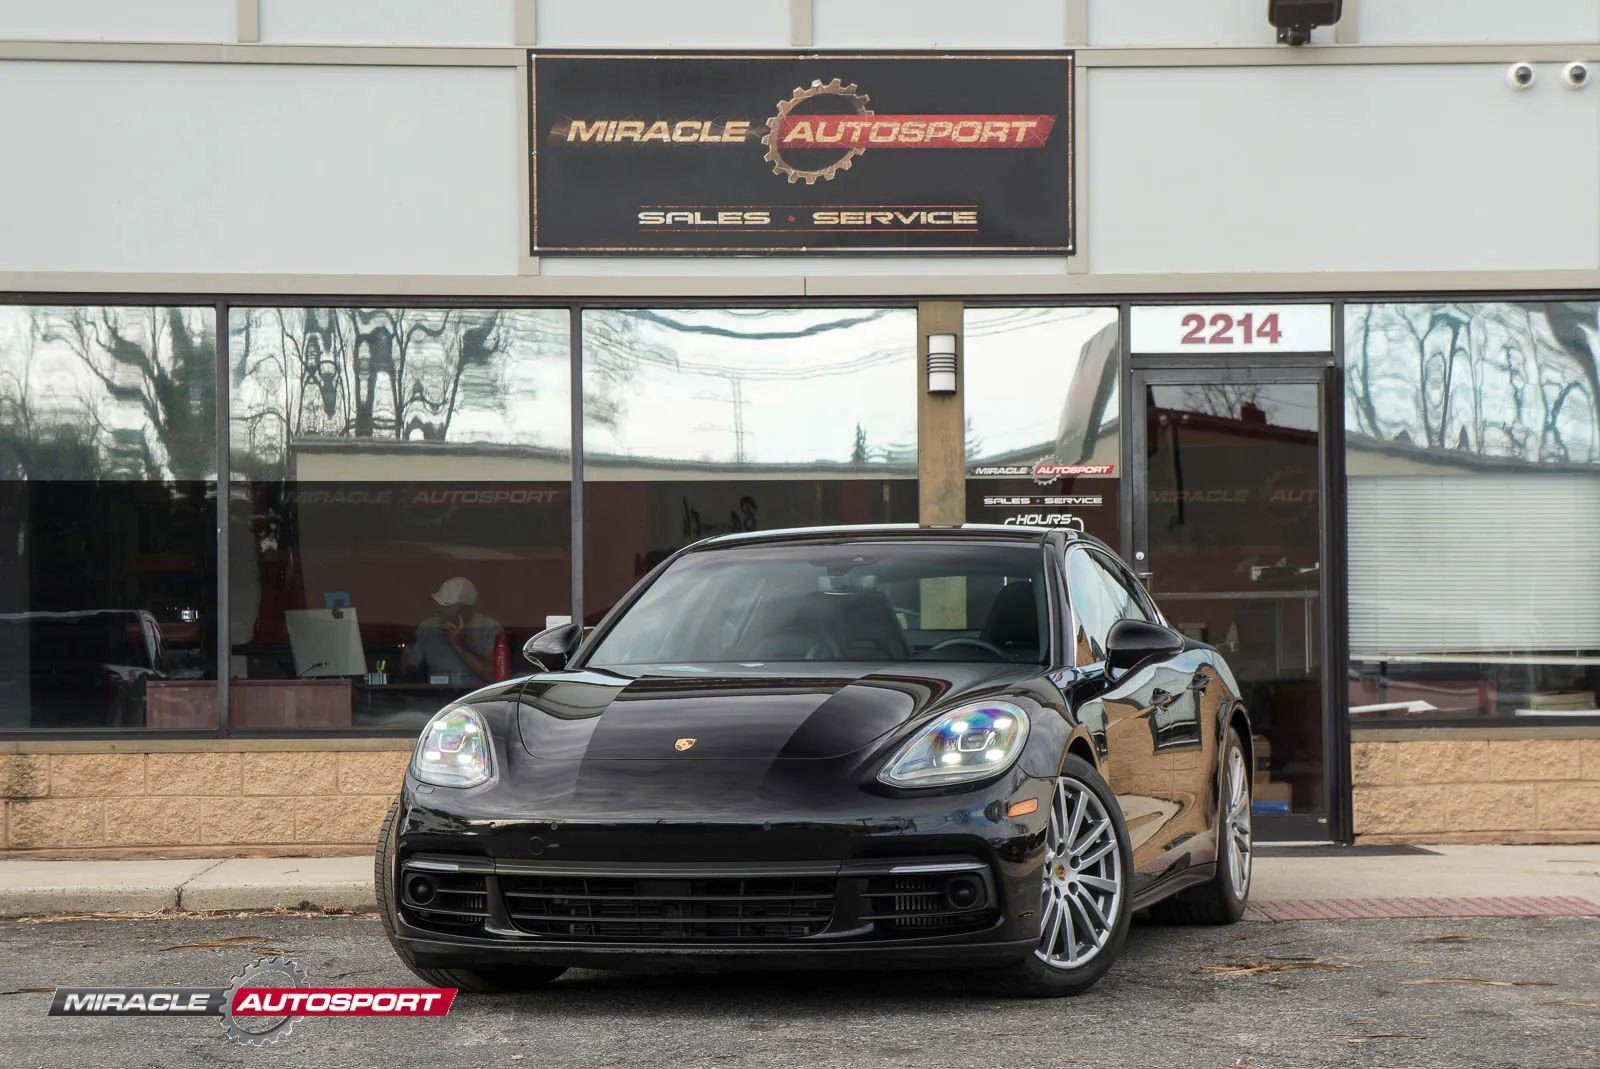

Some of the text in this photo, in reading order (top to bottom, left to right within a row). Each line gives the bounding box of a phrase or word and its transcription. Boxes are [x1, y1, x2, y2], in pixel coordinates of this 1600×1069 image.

[566, 118, 1037, 143] MIRACLE AUTOSPORT
[638, 210, 978, 225] SALES SERVICE
[1180, 312, 1282, 344] 2214
[975, 465, 1111, 475] MIRACLE AUTOSPORT
[284, 490, 559, 504] MIRACLE AUTOSPORT
[983, 497, 1103, 505] SALES SERVICE
[1015, 513, 1072, 525] HOURS
